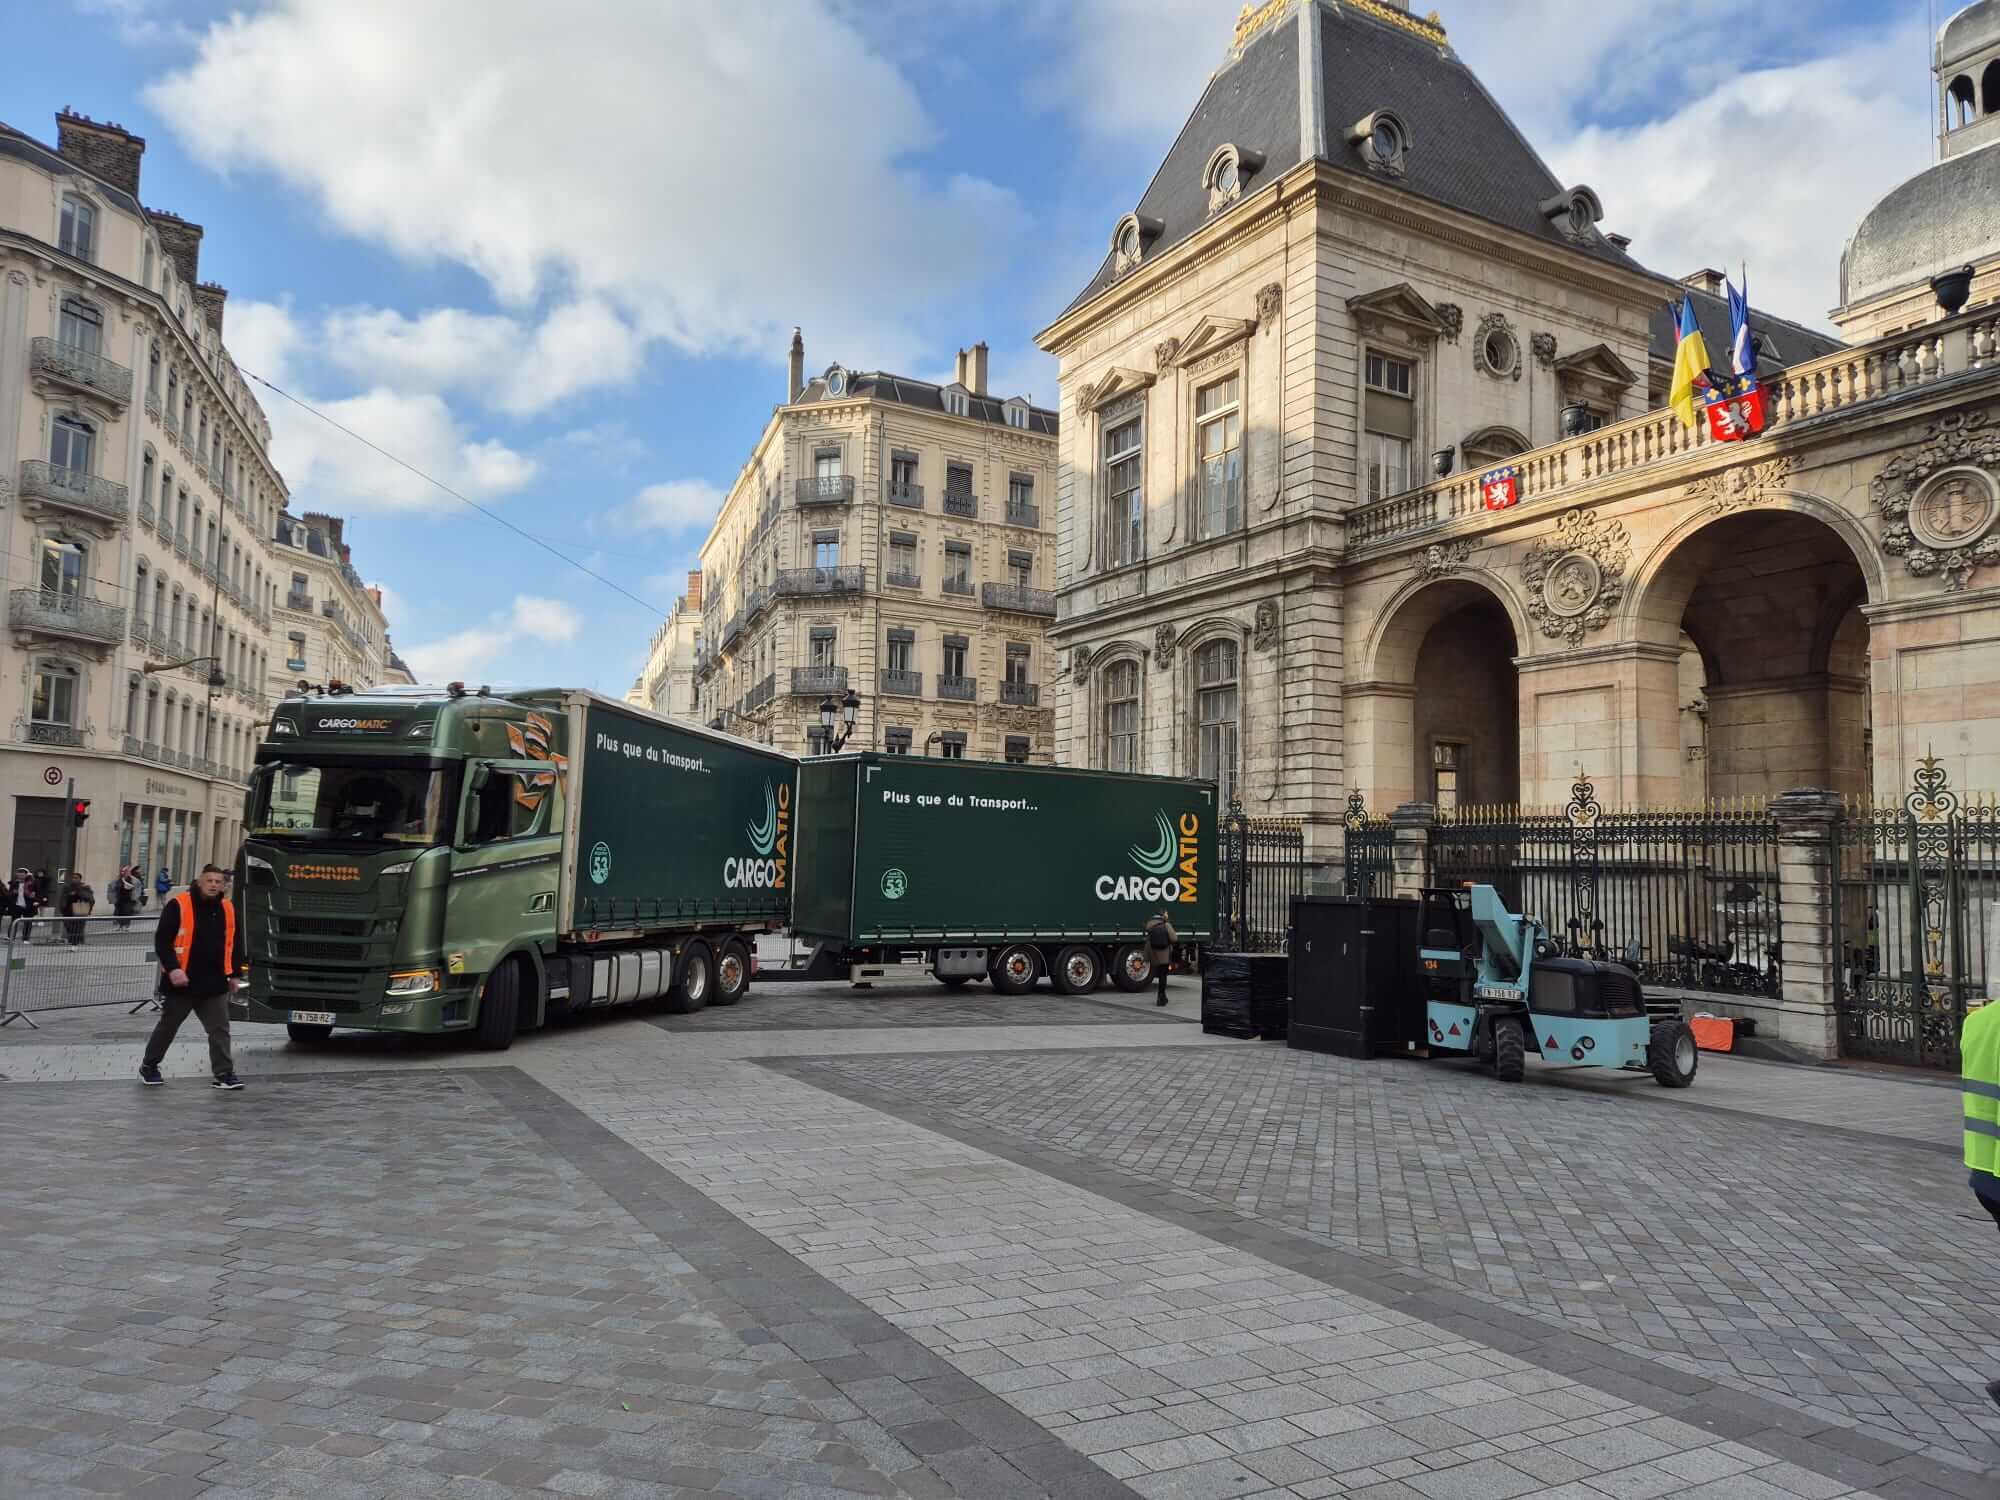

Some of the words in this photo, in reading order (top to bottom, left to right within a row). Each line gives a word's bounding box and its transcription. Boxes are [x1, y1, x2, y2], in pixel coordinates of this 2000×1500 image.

[596, 733, 619, 753] Plus
[623, 742, 642, 759] que
[646, 745, 659, 761] du
[662, 749, 711, 774] Transport...
[882, 790, 911, 804] Plus
[917, 794, 942, 807] que
[947, 794, 964, 806] du
[969, 795, 1039, 811] Transport...
[723, 856, 776, 888] CARGO
[1179, 812, 1199, 902] MATIC
[1095, 875, 1180, 902] CARGO
